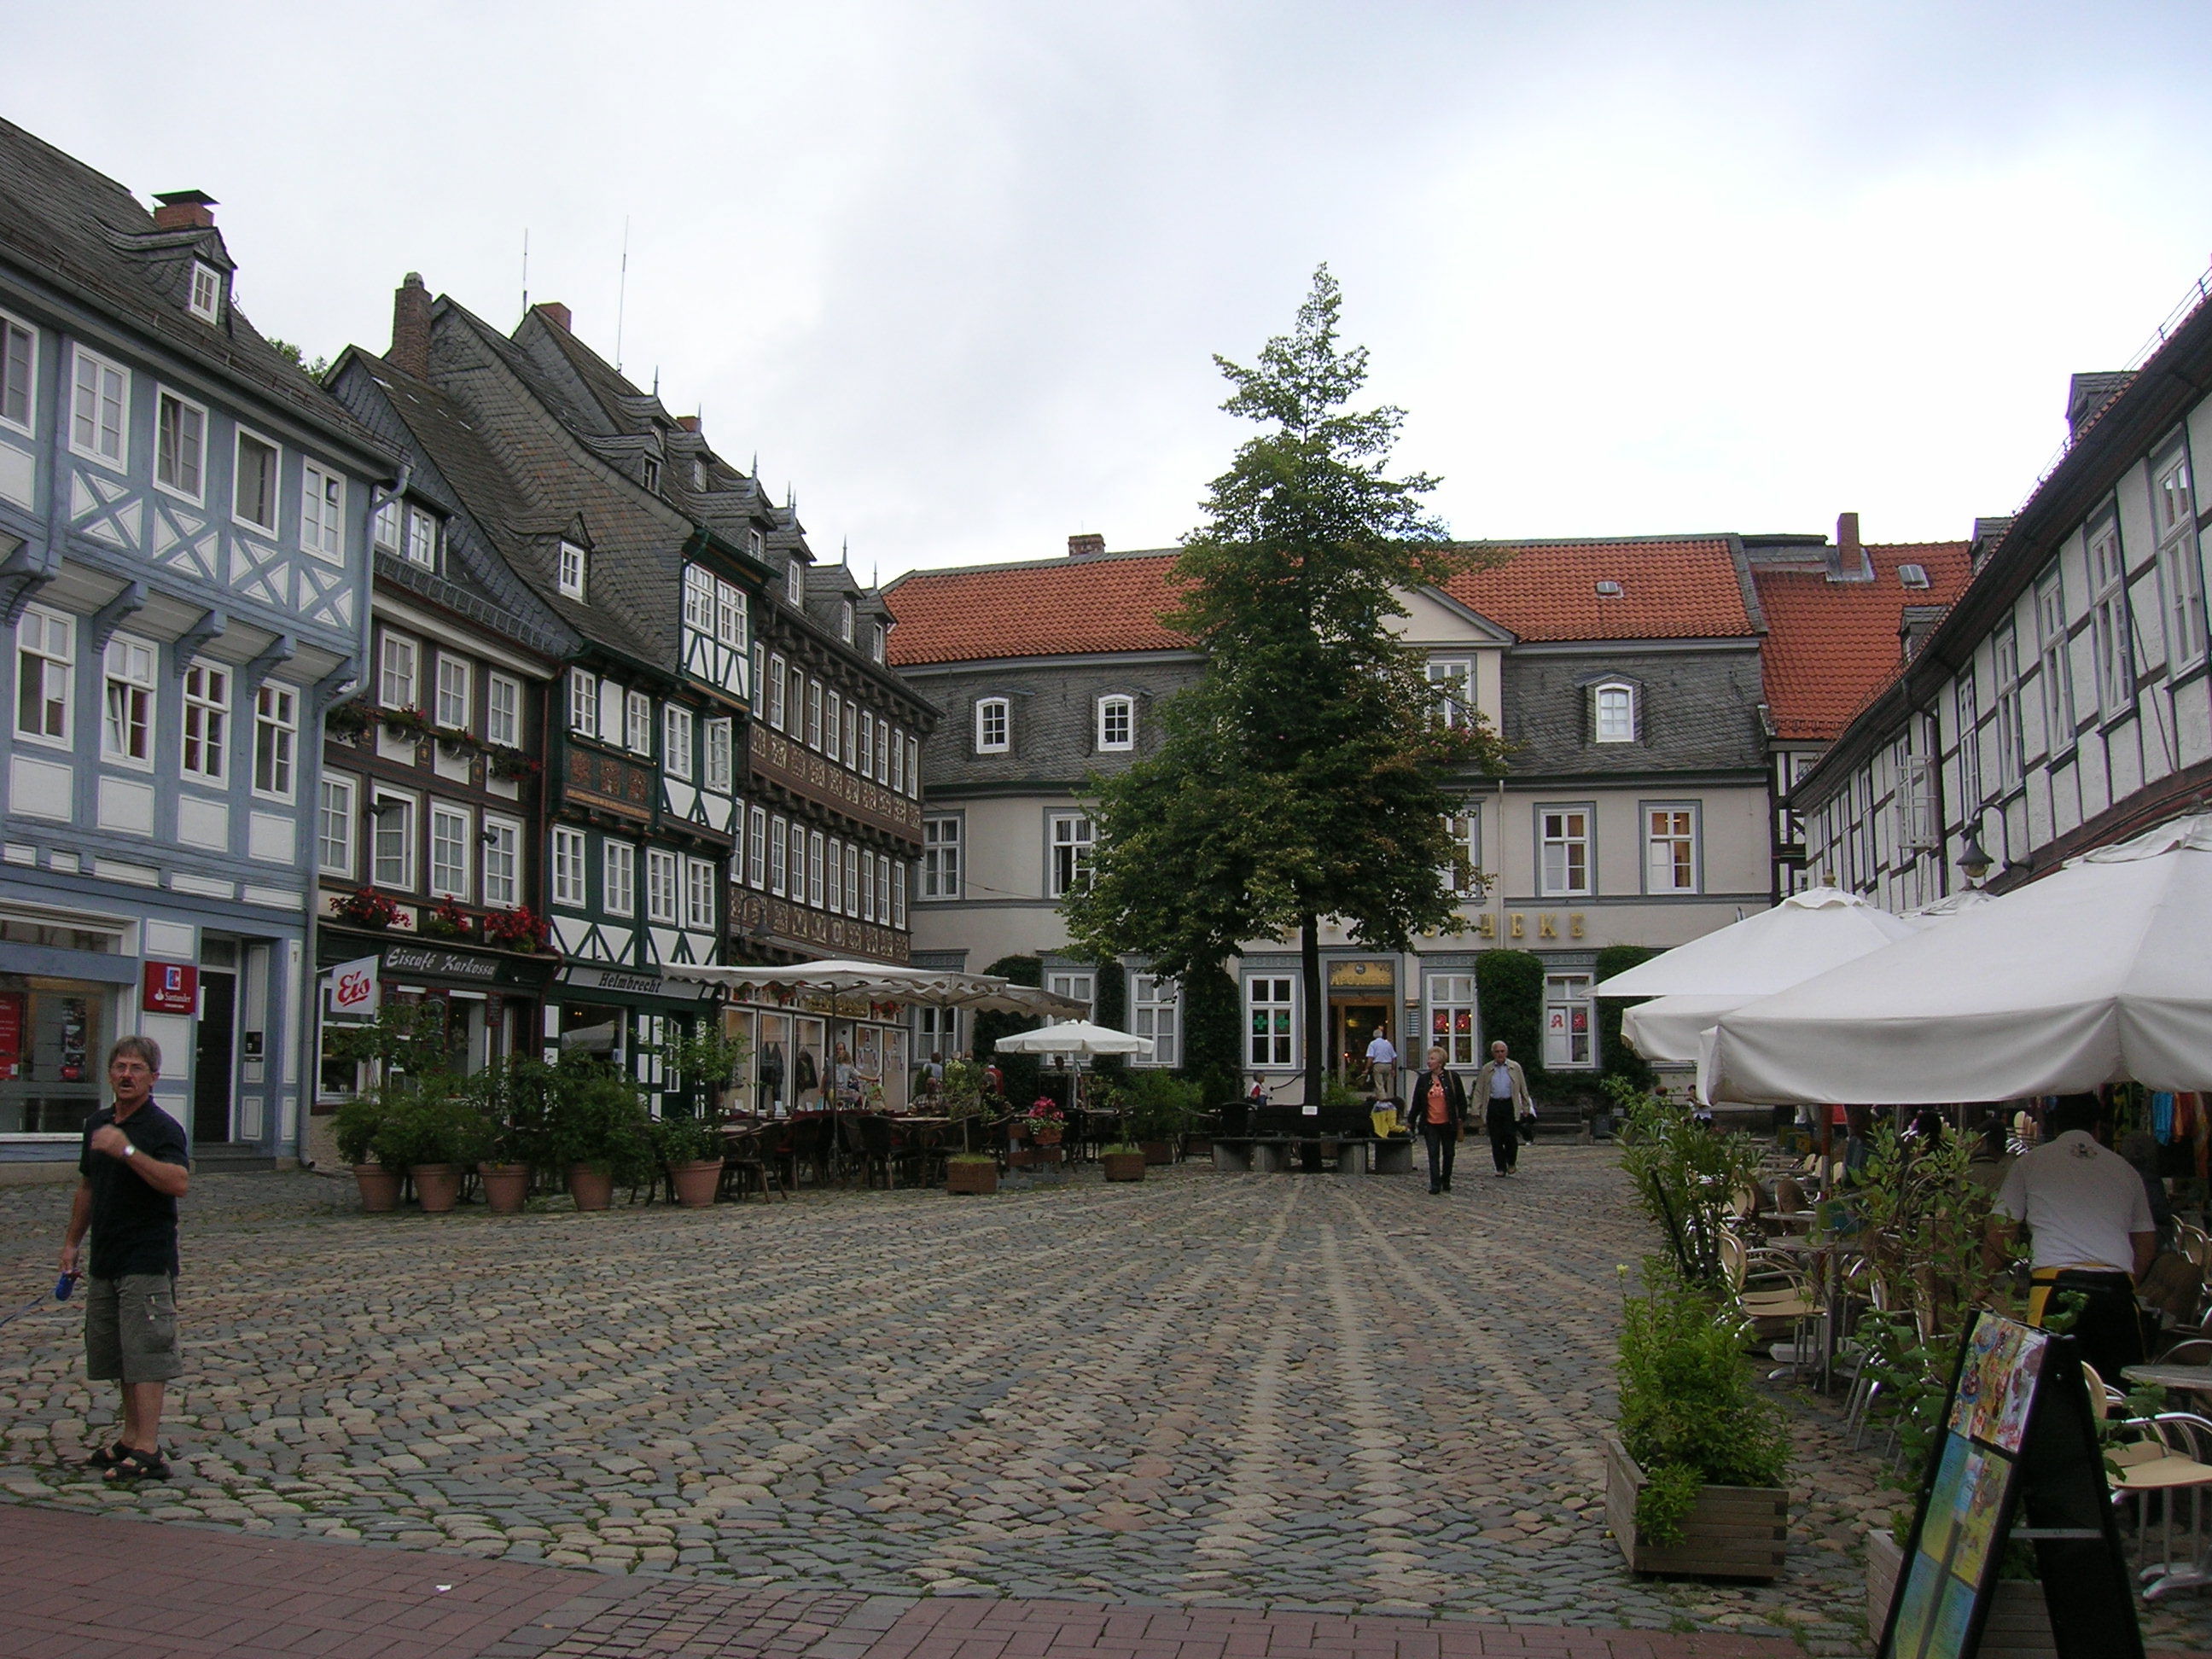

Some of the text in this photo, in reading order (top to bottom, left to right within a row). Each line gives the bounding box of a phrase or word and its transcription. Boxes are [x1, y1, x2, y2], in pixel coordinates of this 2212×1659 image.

[386, 947, 437, 971] Eiscafé
[337, 970, 371, 1006] Eis
[598, 973, 662, 993] Helmbrecht
[164, 992, 192, 1004] Santander
